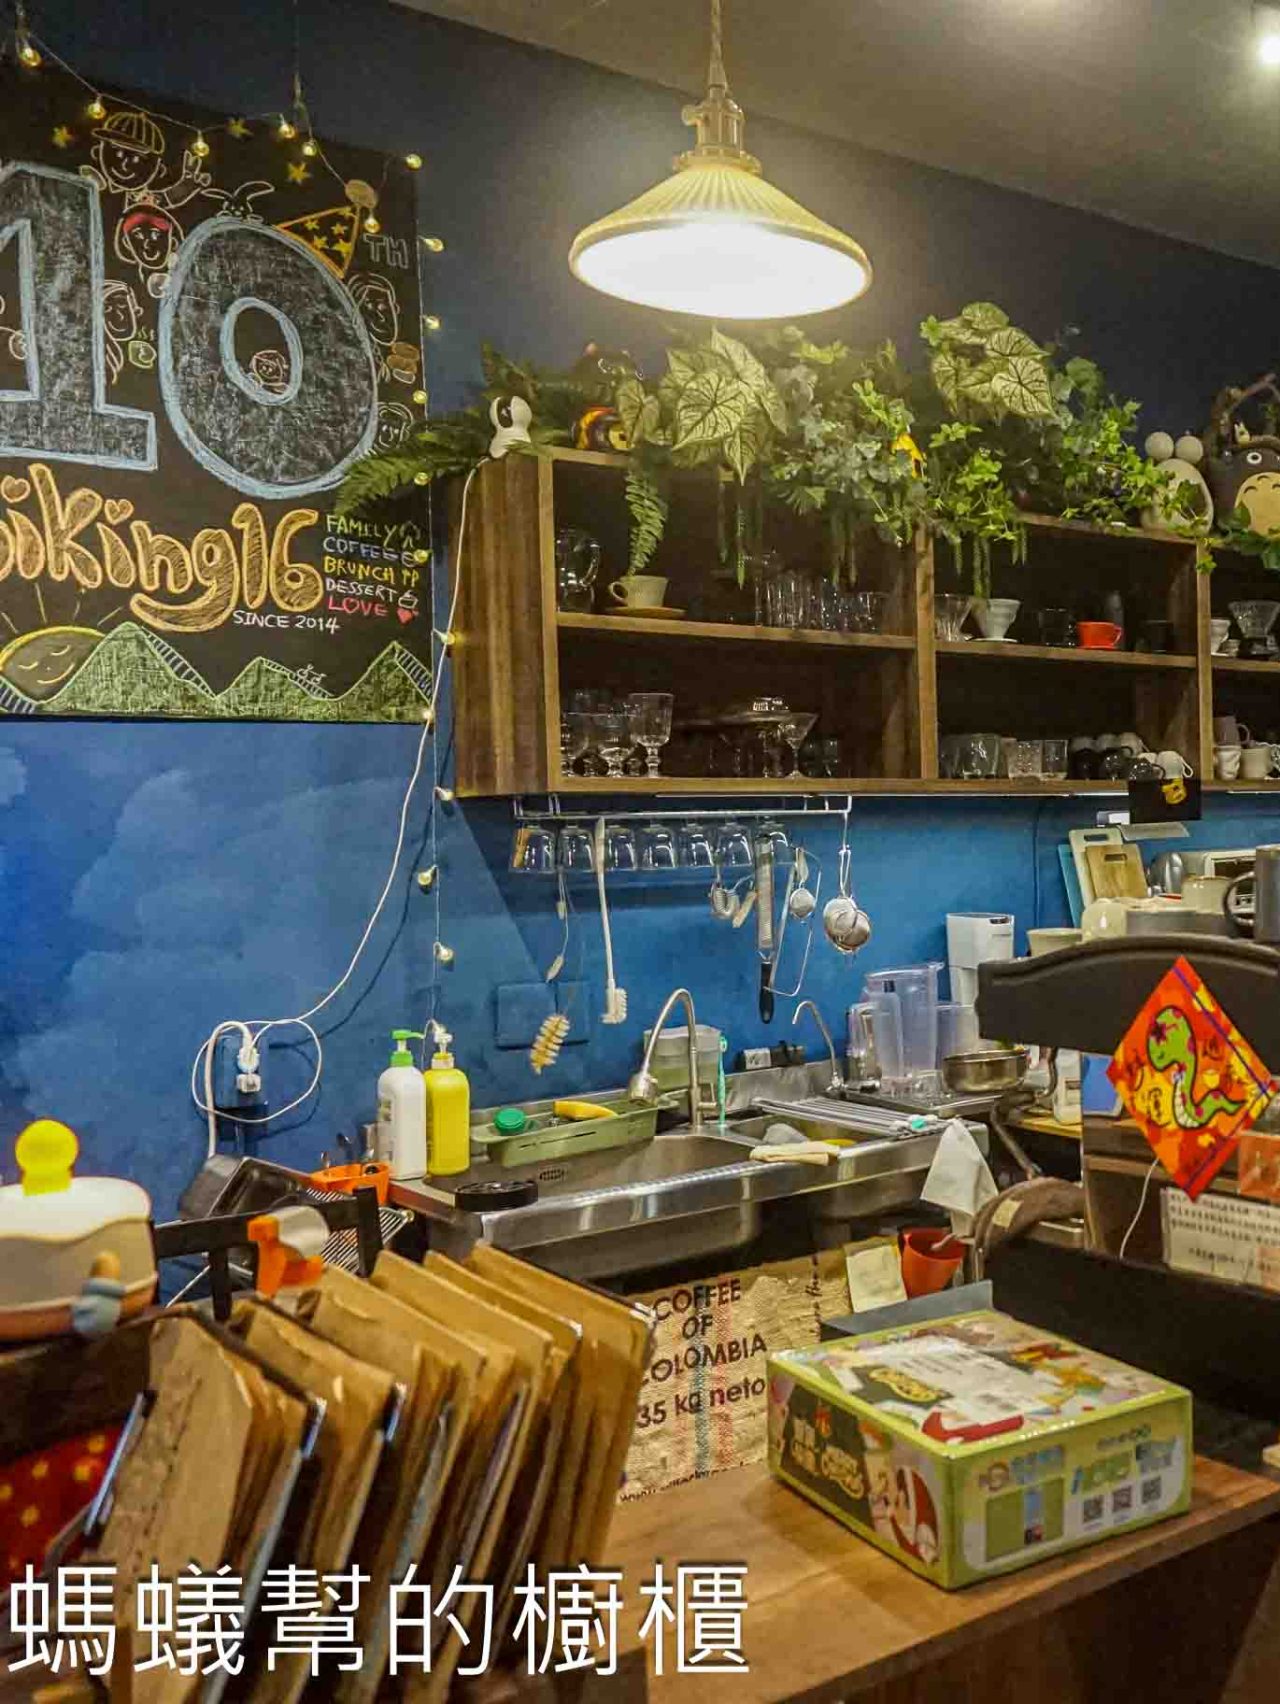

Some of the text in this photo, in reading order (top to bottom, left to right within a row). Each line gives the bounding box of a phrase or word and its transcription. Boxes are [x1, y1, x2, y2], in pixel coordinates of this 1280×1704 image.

[363, 233, 409, 269] TH
[326, 514, 397, 547] FAMILY
[323, 536, 399, 561] COFFEE
[324, 555, 395, 585] BRUNCH
[325, 577, 398, 602] DESSERT
[328, 594, 389, 616] LOVE
[233, 609, 341, 635] SINCE 2014
[653, 1278, 741, 1321] COFFEE
[682, 1314, 713, 1340] OF
[641, 1334, 768, 1387] OLOMBIA
[635, 1377, 766, 1428] 35 kg neto
